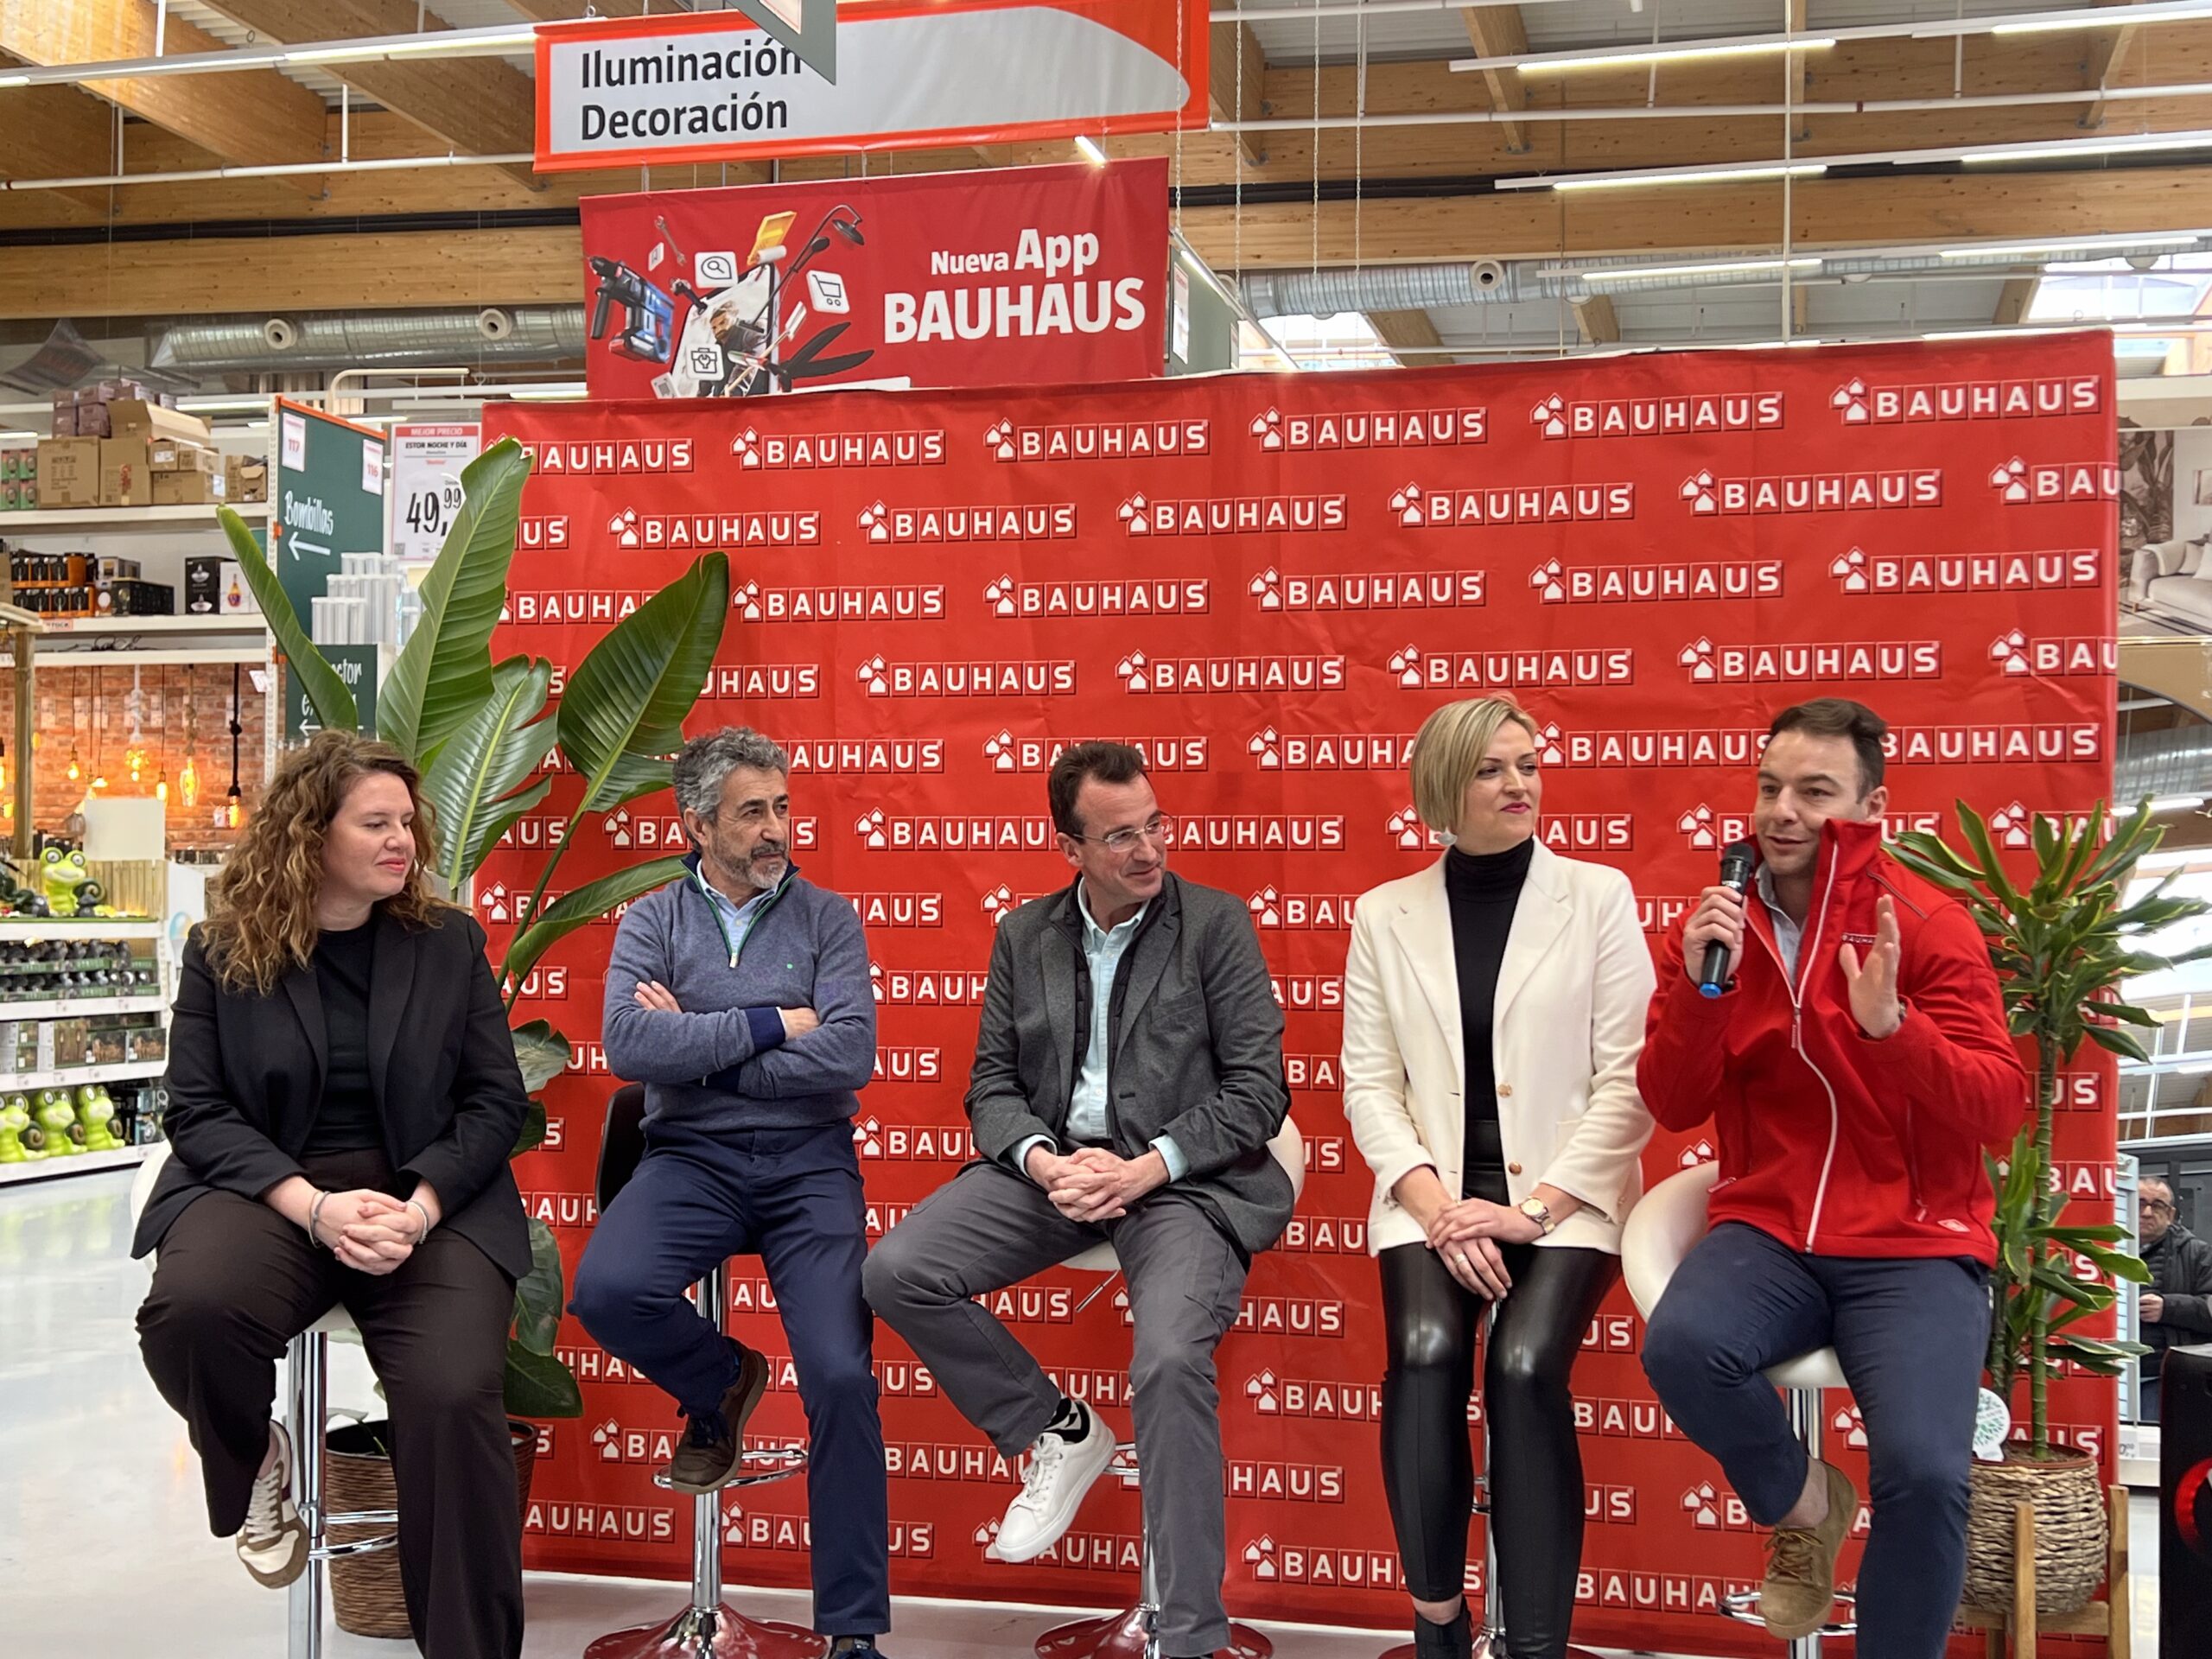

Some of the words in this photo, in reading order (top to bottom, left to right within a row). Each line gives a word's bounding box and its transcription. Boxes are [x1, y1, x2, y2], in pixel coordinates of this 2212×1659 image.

[582, 37, 801, 89] Iluminación
[582, 91, 787, 141] Decoración
[931, 251, 1009, 276] Nueva
[1014, 228, 1099, 278] App
[884, 276, 1146, 344] BAUHAUS
[1574, 397, 1780, 431] BAUHAUS
[1877, 381, 2096, 417] BAUHAUS
[1022, 424, 1205, 455] BAUHAUS
[1290, 413, 1483, 445] BAUHAUS
[767, 435, 942, 463] BAUHAUS
[1431, 487, 1630, 520] BAUHAUS
[1725, 474, 1937, 509] BAUHAUS
[283, 490, 334, 537] Bombillas
[895, 509, 1072, 537] BAUHAUS
[1156, 499, 1343, 530] BAUHAUS
[645, 516, 817, 543] BAUHAUS
[1573, 566, 1779, 597] BAUHAUS
[1876, 555, 2096, 588] BAUHAUS
[768, 591, 942, 616] BAUHAUS
[1023, 584, 1205, 612] BAUHAUS
[1288, 575, 1482, 605] BAUHAUS
[518, 595, 637, 619] BAUHA
[1156, 660, 1342, 688] BAUHAUS
[1429, 654, 1629, 683] BAUHAUS
[1724, 646, 1936, 677] BAUHAUS
[701, 670, 817, 695] UHAUS
[894, 665, 1072, 691] BAUHAUS
[792, 745, 941, 769] AUHAUS
[1287, 740, 1415, 765] BAUHA
[893, 822, 1045, 846] BAUHAU
[892, 976, 988, 1001] BAUH
[1238, 1302, 1339, 1330] HAUS
[884, 1447, 1027, 1478] BAUHA
[1233, 1466, 1339, 1496] HAUS
[525, 1505, 671, 1536] AUHAUS
[1285, 1552, 1406, 1585] BAUH
